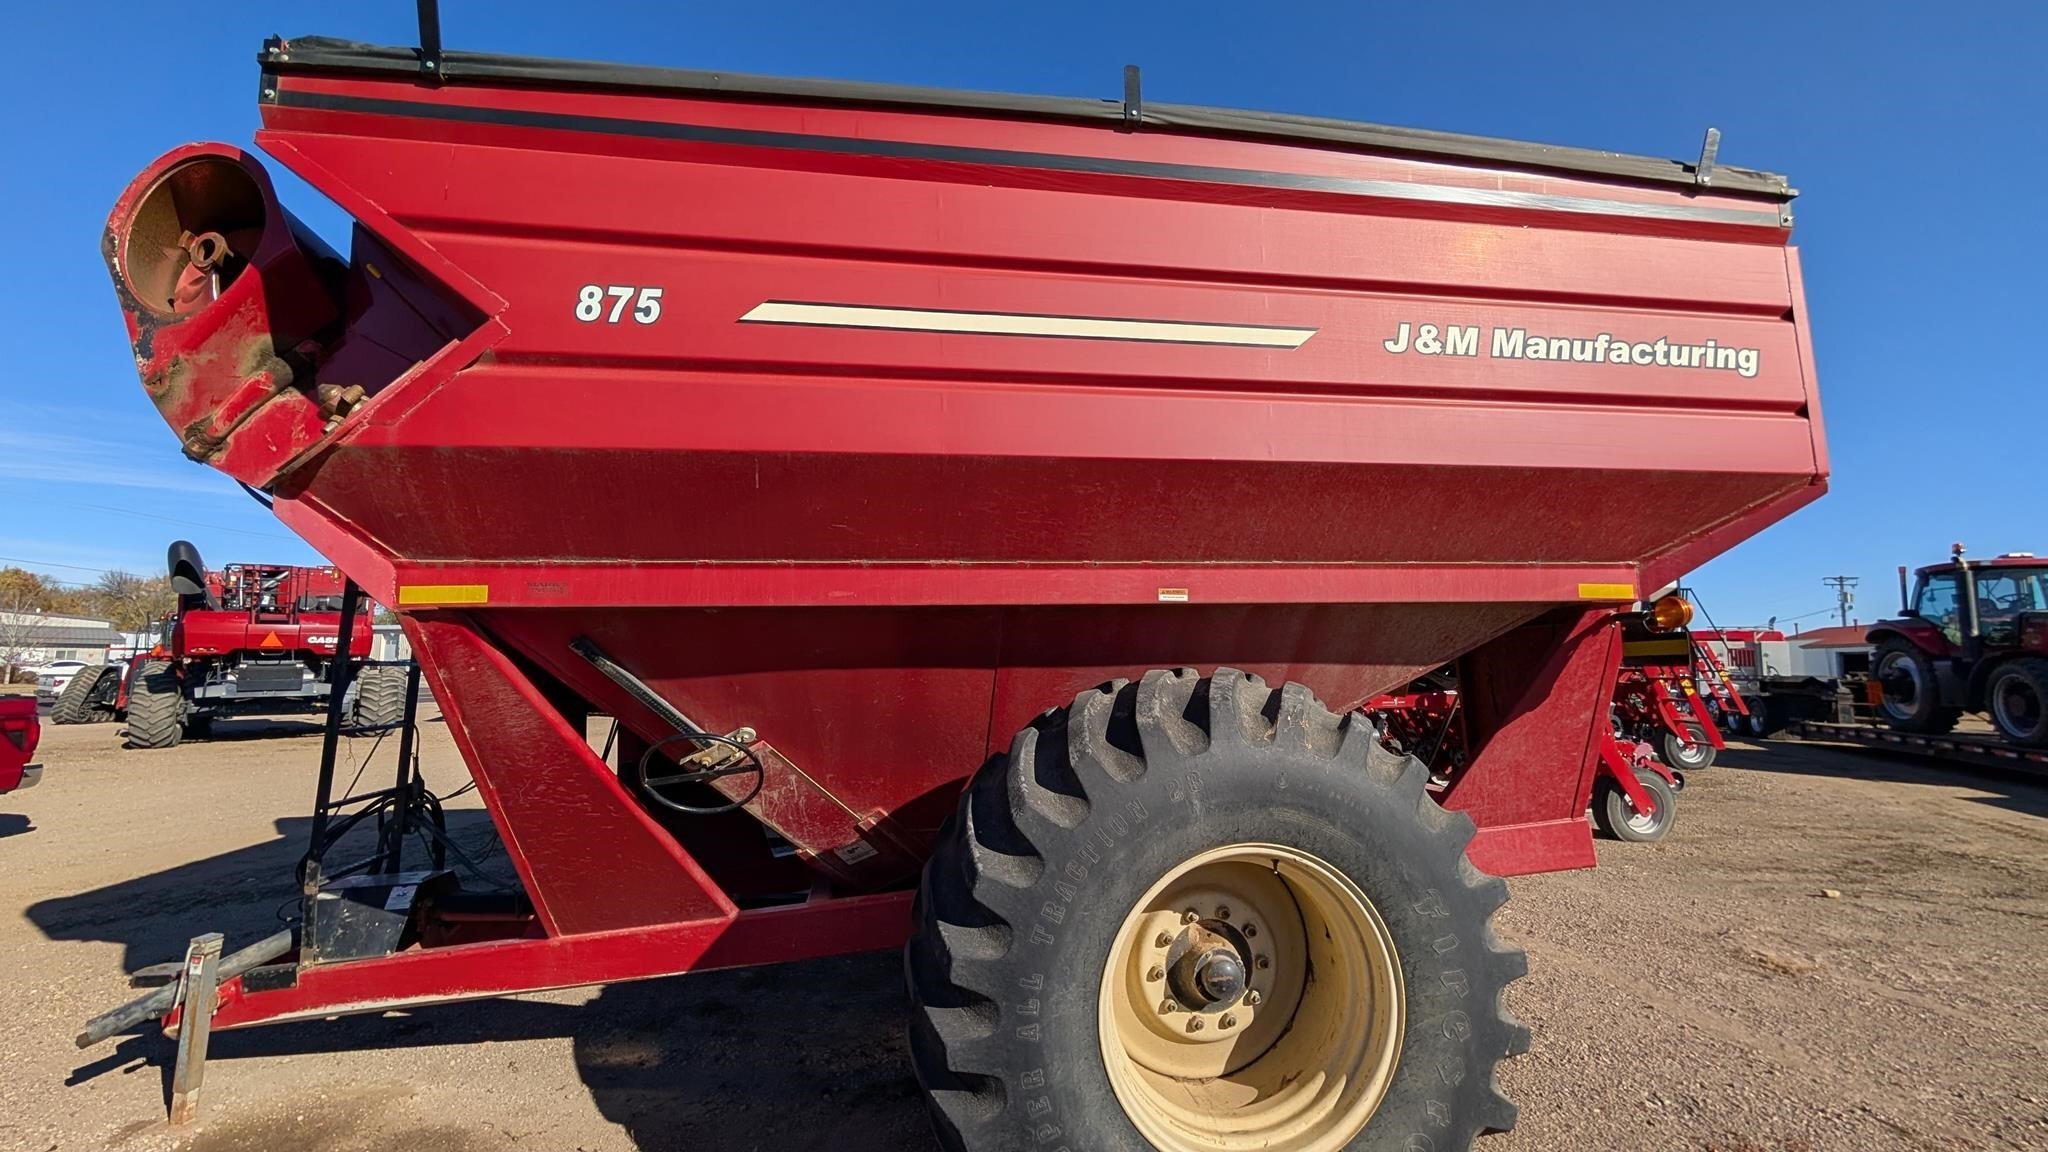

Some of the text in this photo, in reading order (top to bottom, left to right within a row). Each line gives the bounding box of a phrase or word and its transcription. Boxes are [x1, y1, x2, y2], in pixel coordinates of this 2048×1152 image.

[574, 284, 663, 325] 875
[1383, 322, 1760, 378] J&M Manufacturing
[1029, 798, 1148, 945] TRACTION
[1016, 974, 1044, 1041] ALL
[1021, 1068, 1070, 1152] PER
